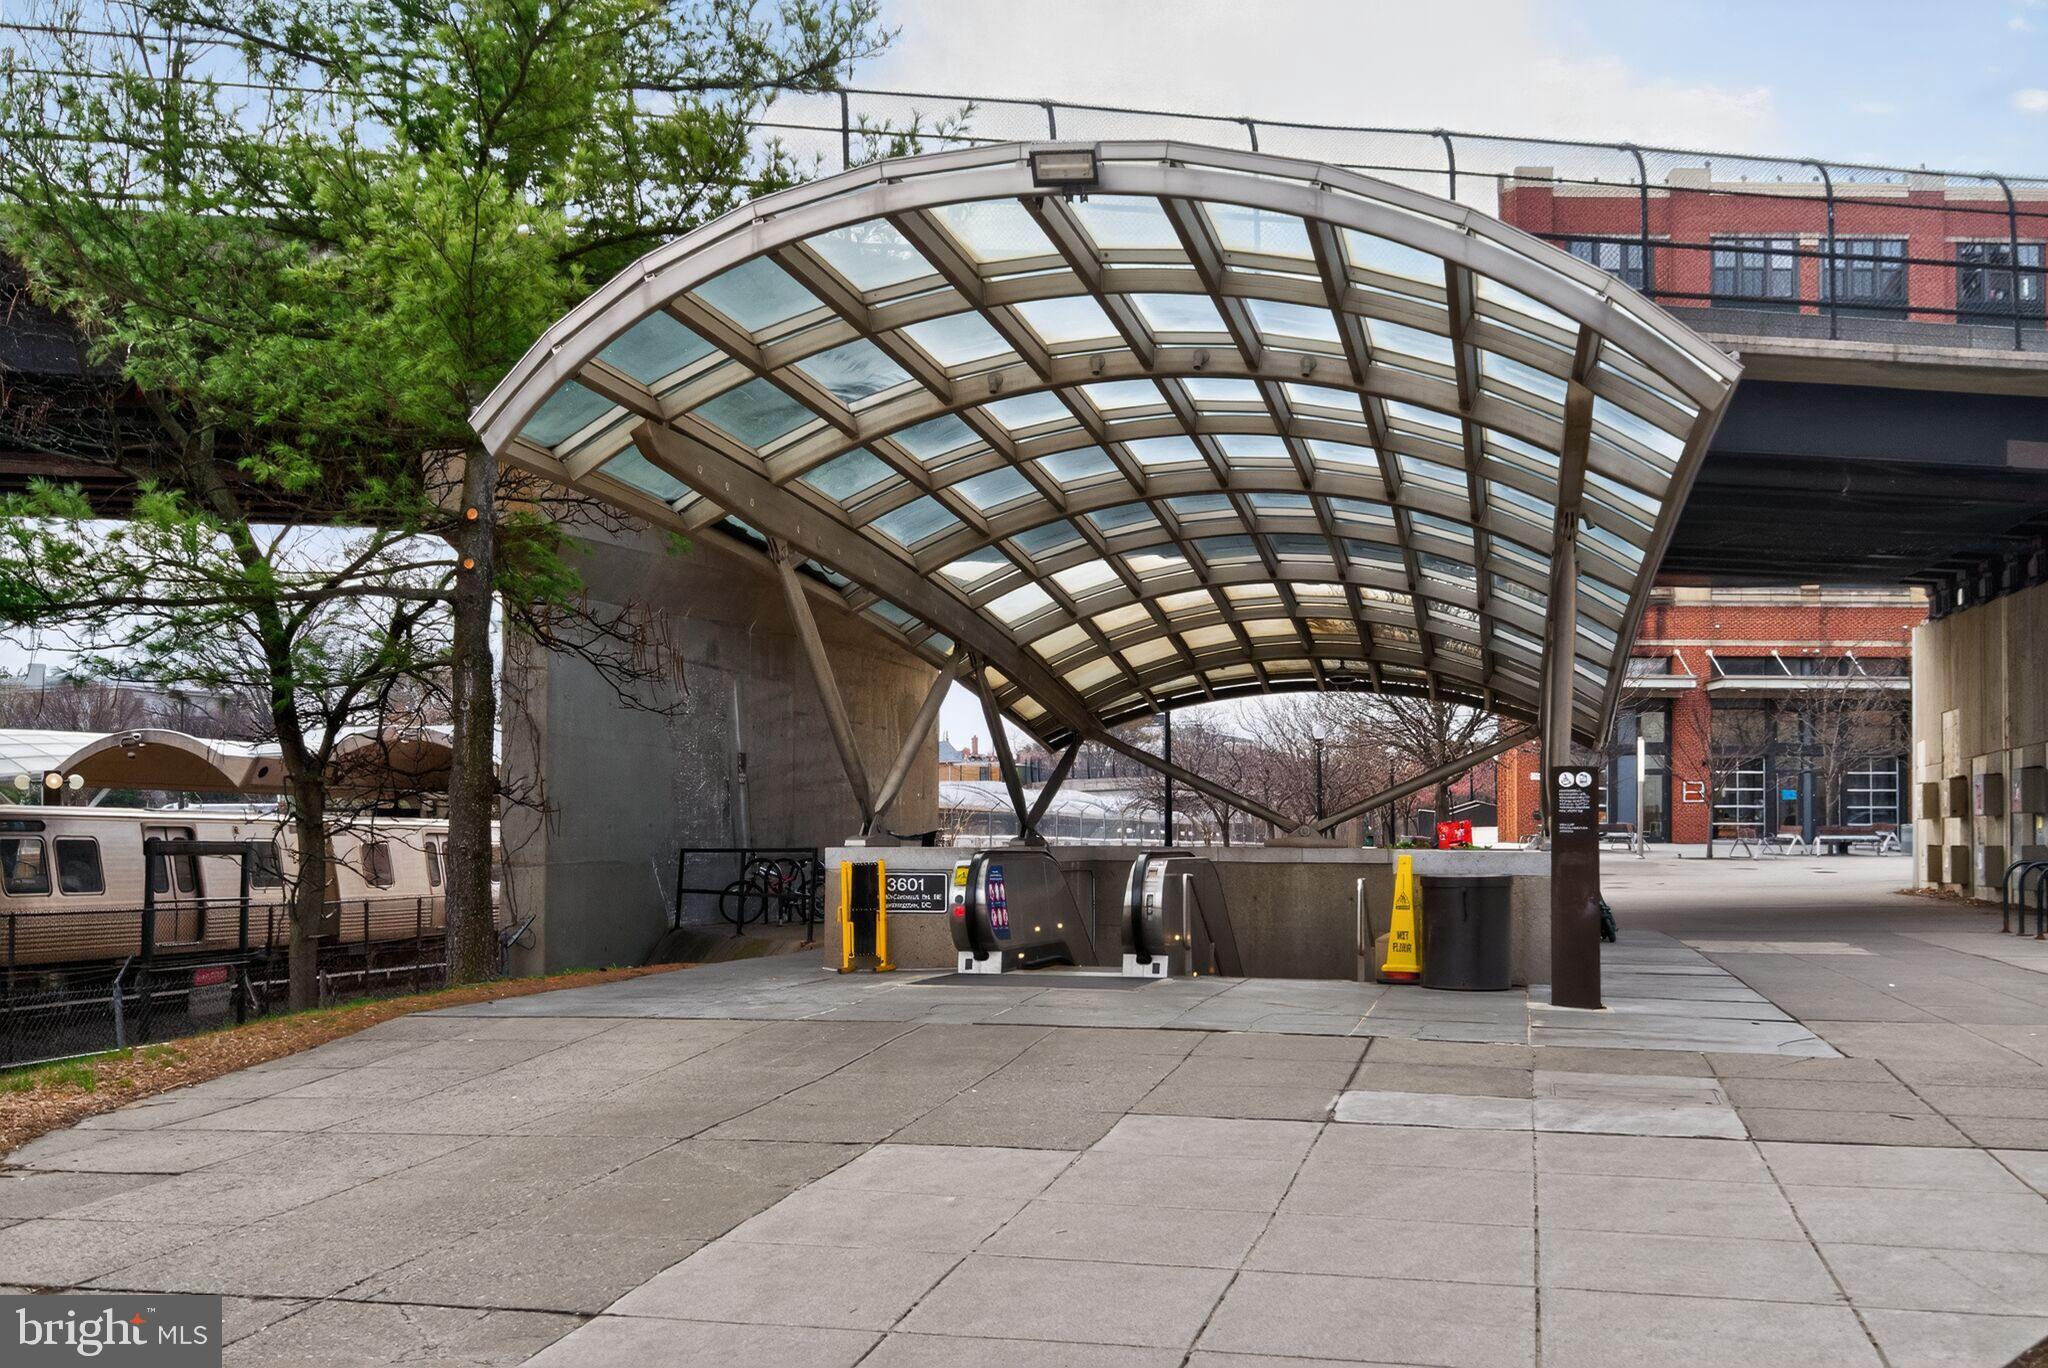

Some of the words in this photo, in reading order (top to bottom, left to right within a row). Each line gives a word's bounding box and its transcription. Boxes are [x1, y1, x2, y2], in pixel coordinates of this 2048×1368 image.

[886, 877, 925, 891] 3601
[1396, 930, 1409, 940] WET
[1392, 942, 1411, 952] FLOOR
